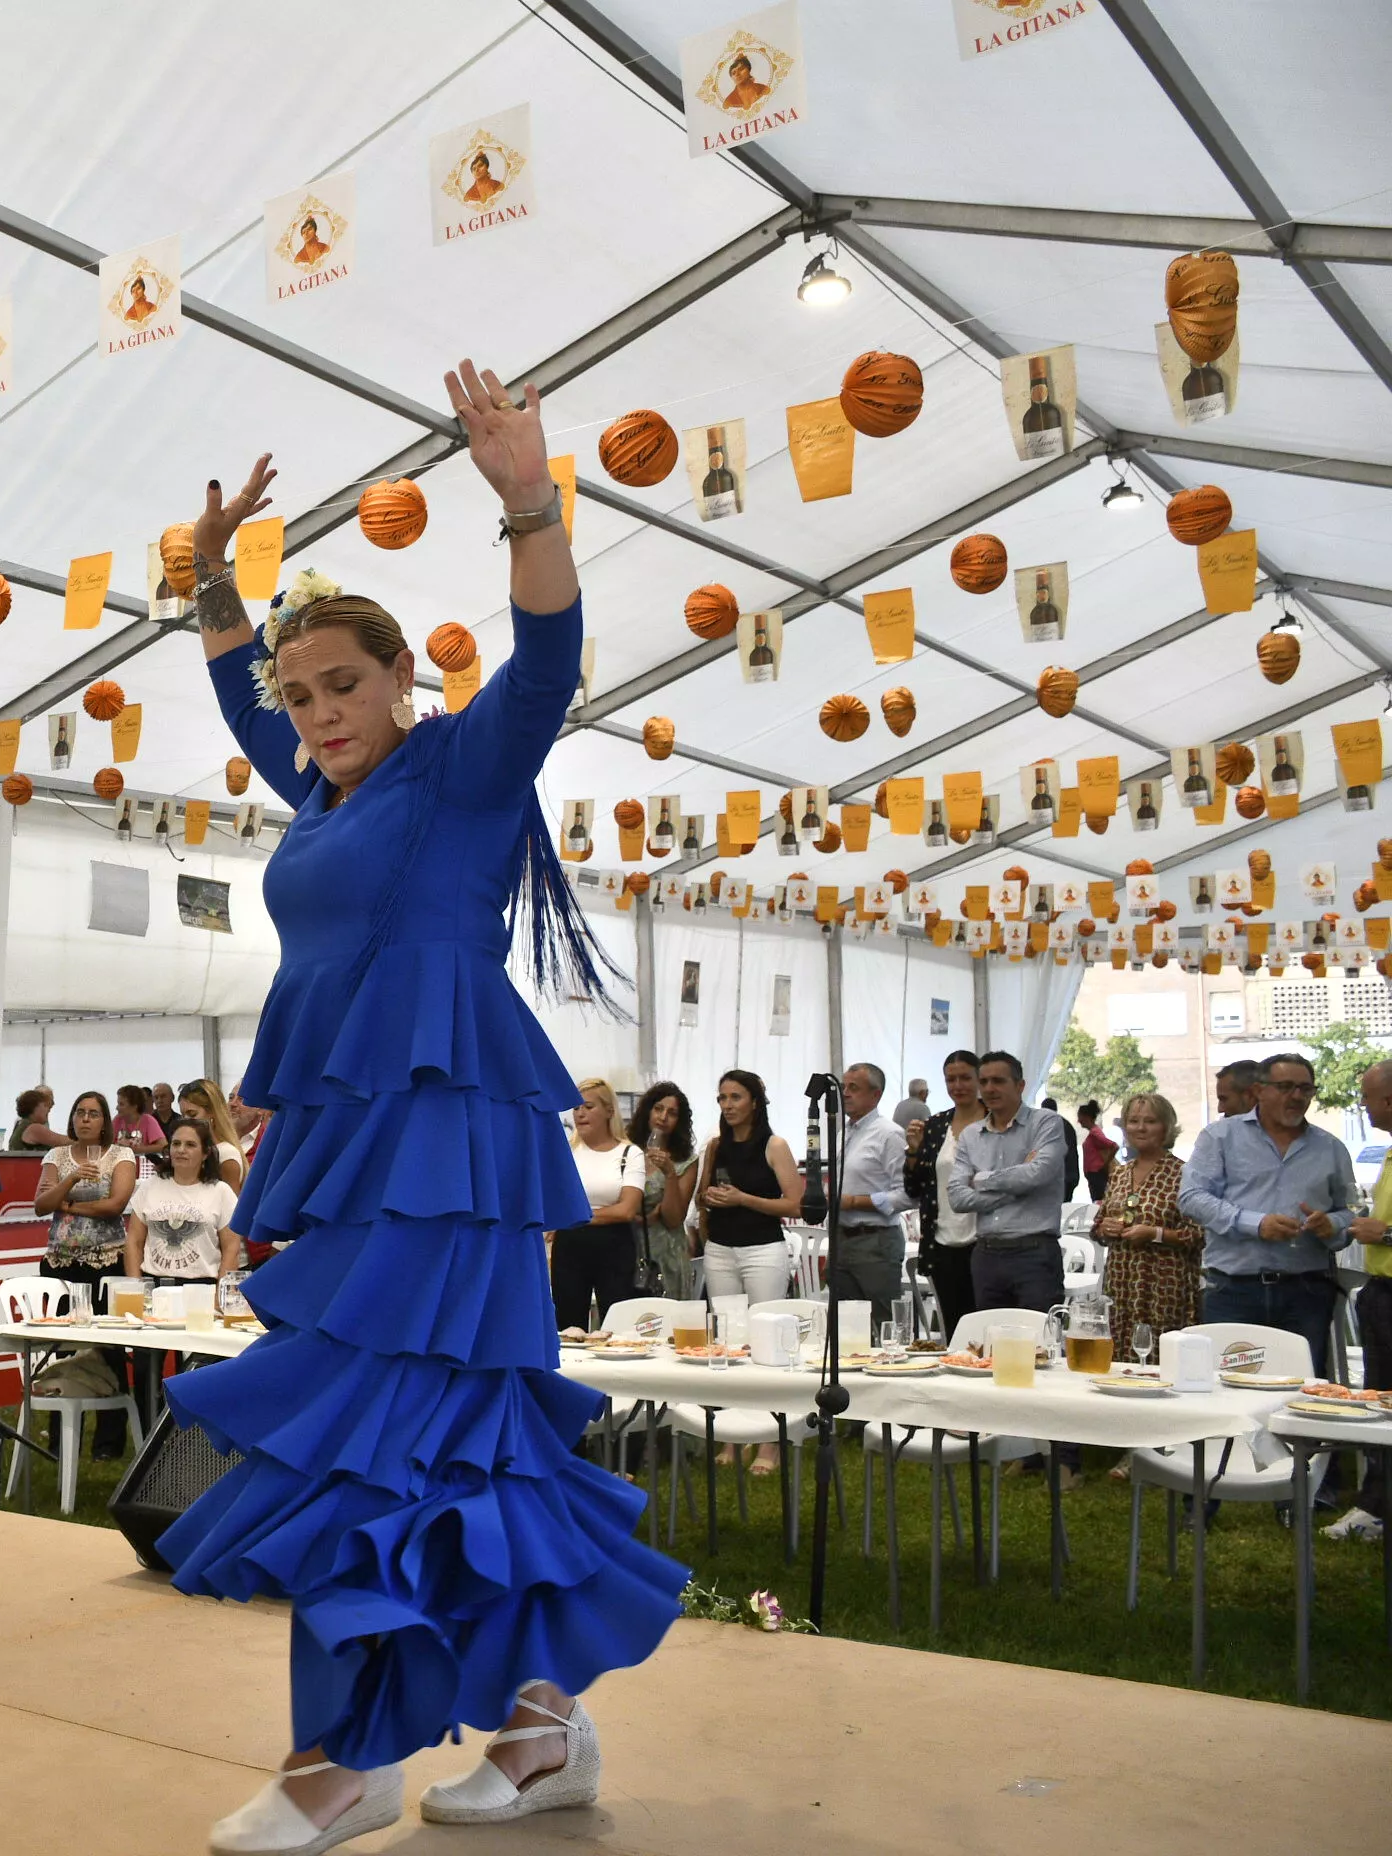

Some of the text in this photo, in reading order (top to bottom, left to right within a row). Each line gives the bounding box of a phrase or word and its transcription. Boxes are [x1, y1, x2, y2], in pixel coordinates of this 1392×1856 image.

[974, 1, 1086, 54] LA GITANA
[703, 107, 799, 151] LA GITANA
[445, 203, 528, 240] LA GITANA
[278, 264, 348, 300] LA GITANA
[108, 325, 175, 354] LA GITANA
[151, 1248, 200, 1269] FREE MIND
[1220, 1350, 1265, 1367] San Miguel
